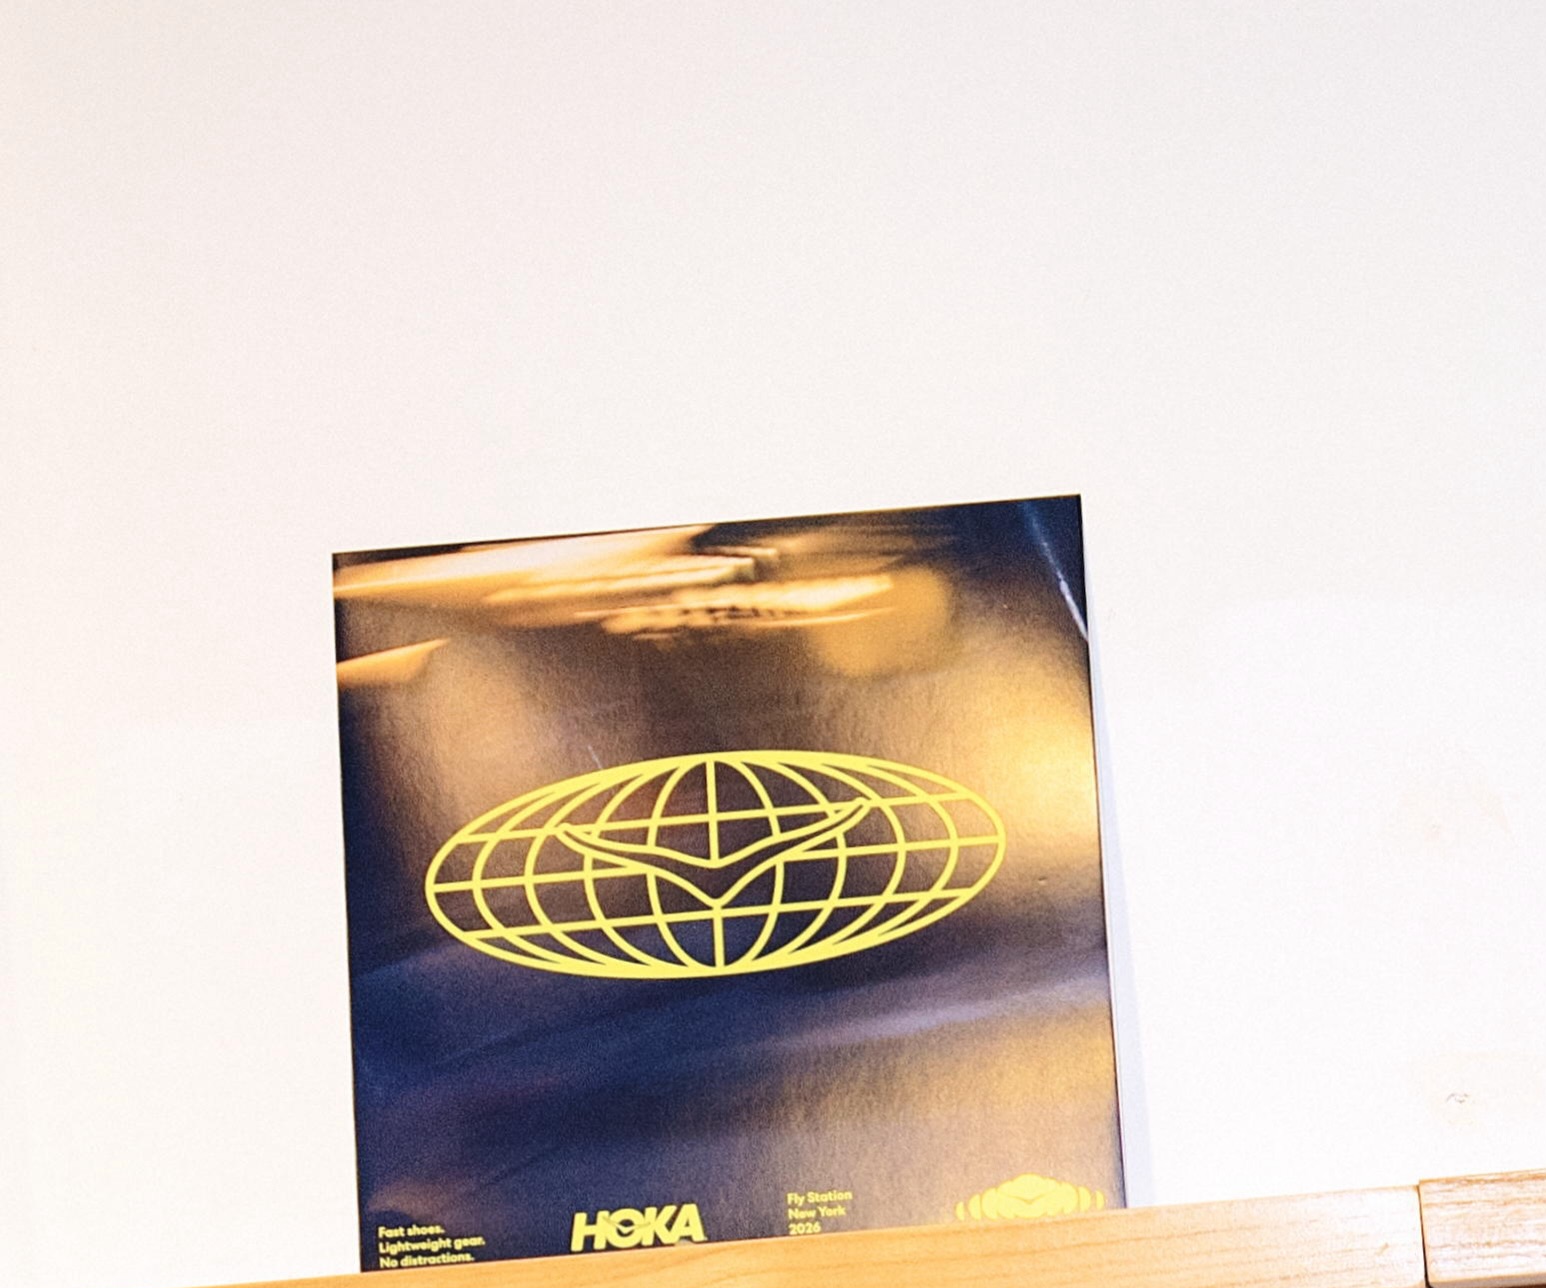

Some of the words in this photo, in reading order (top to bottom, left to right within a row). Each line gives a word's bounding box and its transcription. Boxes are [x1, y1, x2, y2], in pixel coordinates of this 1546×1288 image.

[787, 1192, 805, 1207] Fly
[807, 1190, 853, 1203] Station
[788, 1208, 816, 1220] New
[817, 1205, 846, 1217] York
[378, 1226, 405, 1238] Fast
[407, 1224, 445, 1236] shoes.
[570, 1203, 706, 1252] HOKA
[788, 1221, 822, 1235] 2026
[379, 1238, 452, 1255] Lightweight
[453, 1237, 486, 1250] gear.
[380, 1257, 399, 1268] No
[400, 1252, 475, 1267] distractions.
